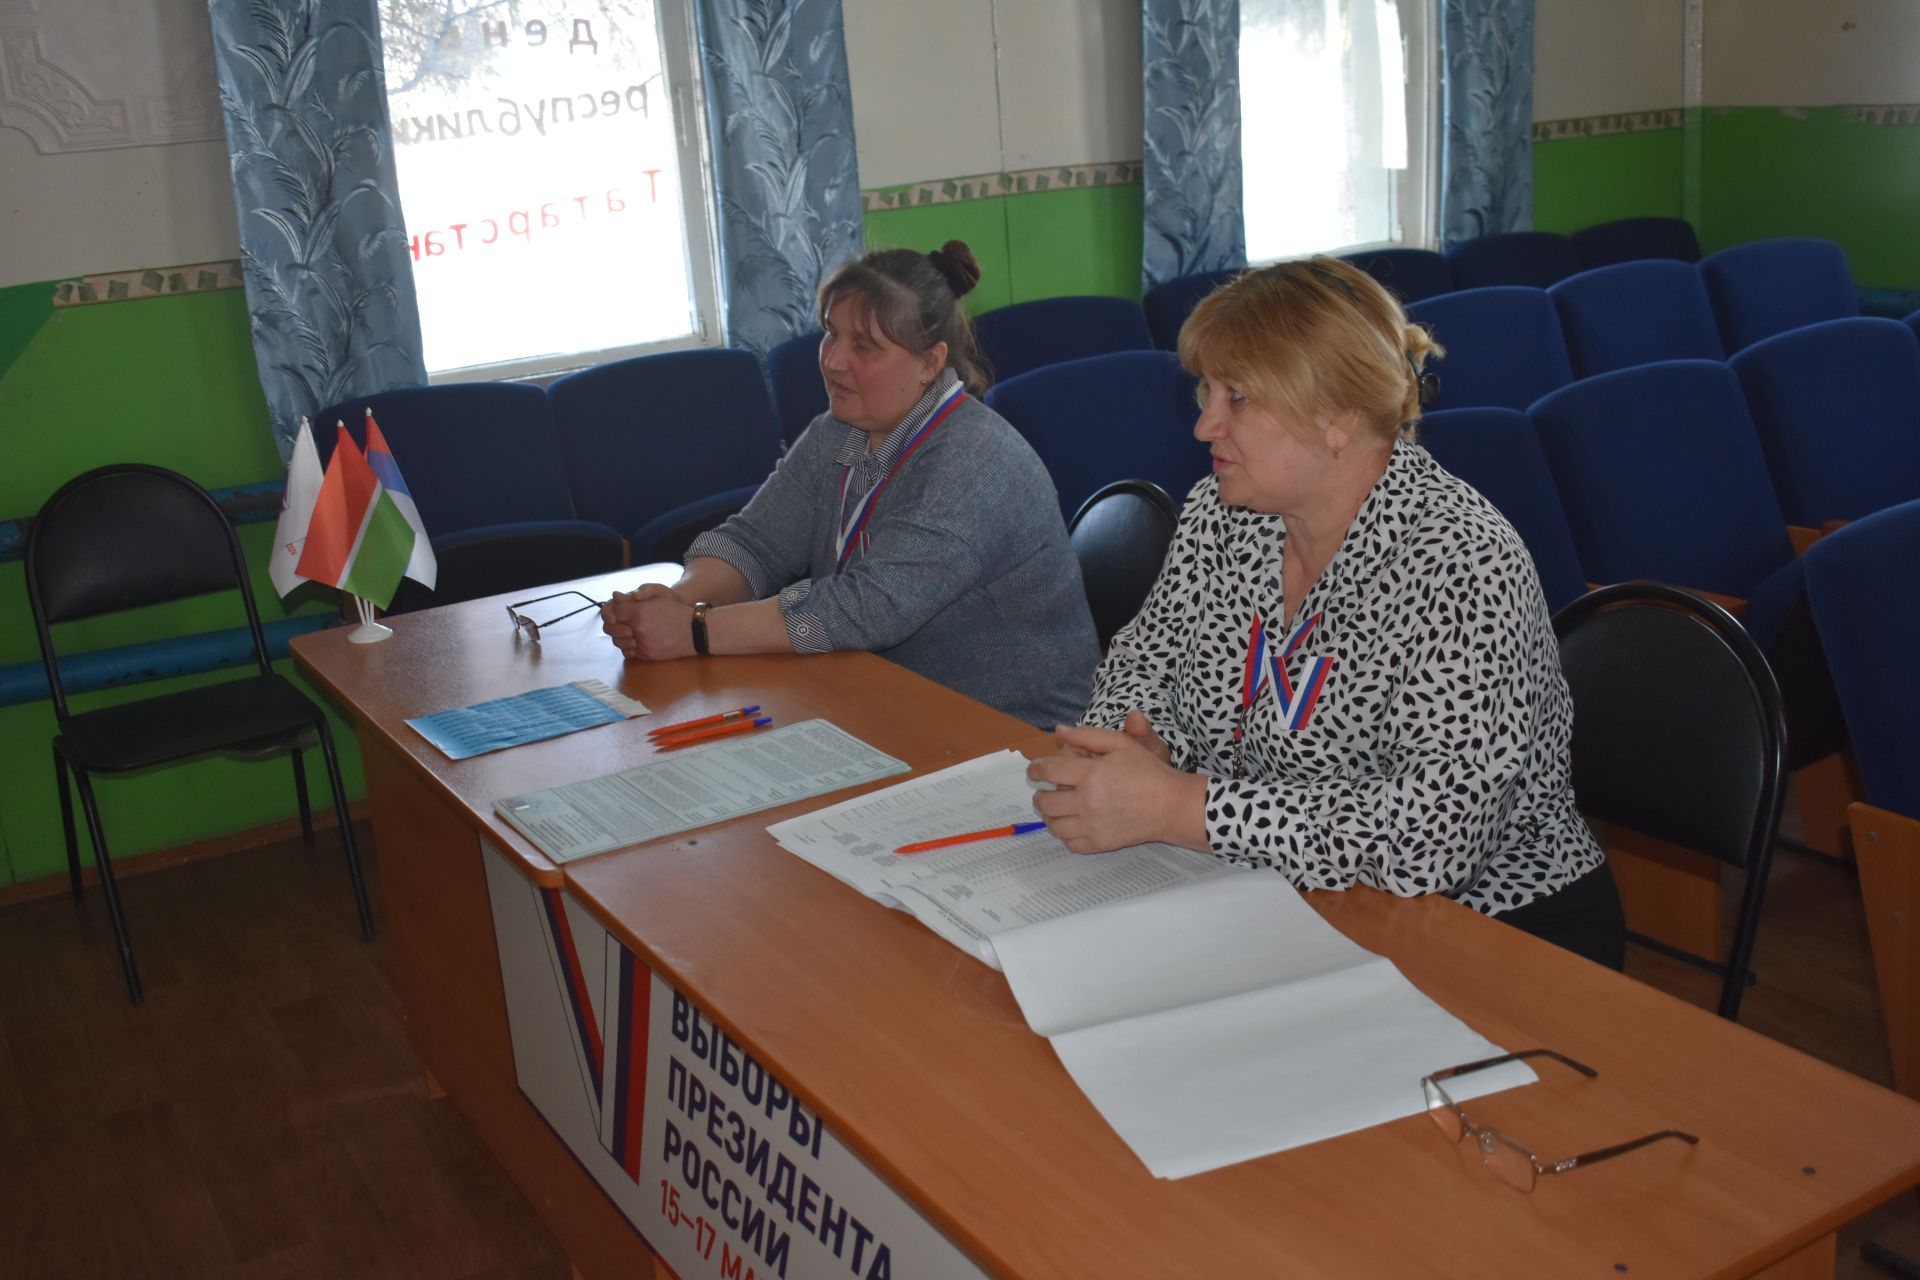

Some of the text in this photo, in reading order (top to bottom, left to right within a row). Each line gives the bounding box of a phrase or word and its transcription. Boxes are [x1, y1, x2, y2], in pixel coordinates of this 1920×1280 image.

[671, 989, 825, 1160] ВЫБОРЫ
[663, 1118, 791, 1280] РОССИИ
[667, 1054, 892, 1280] ПРЕЗИДЕНТА
